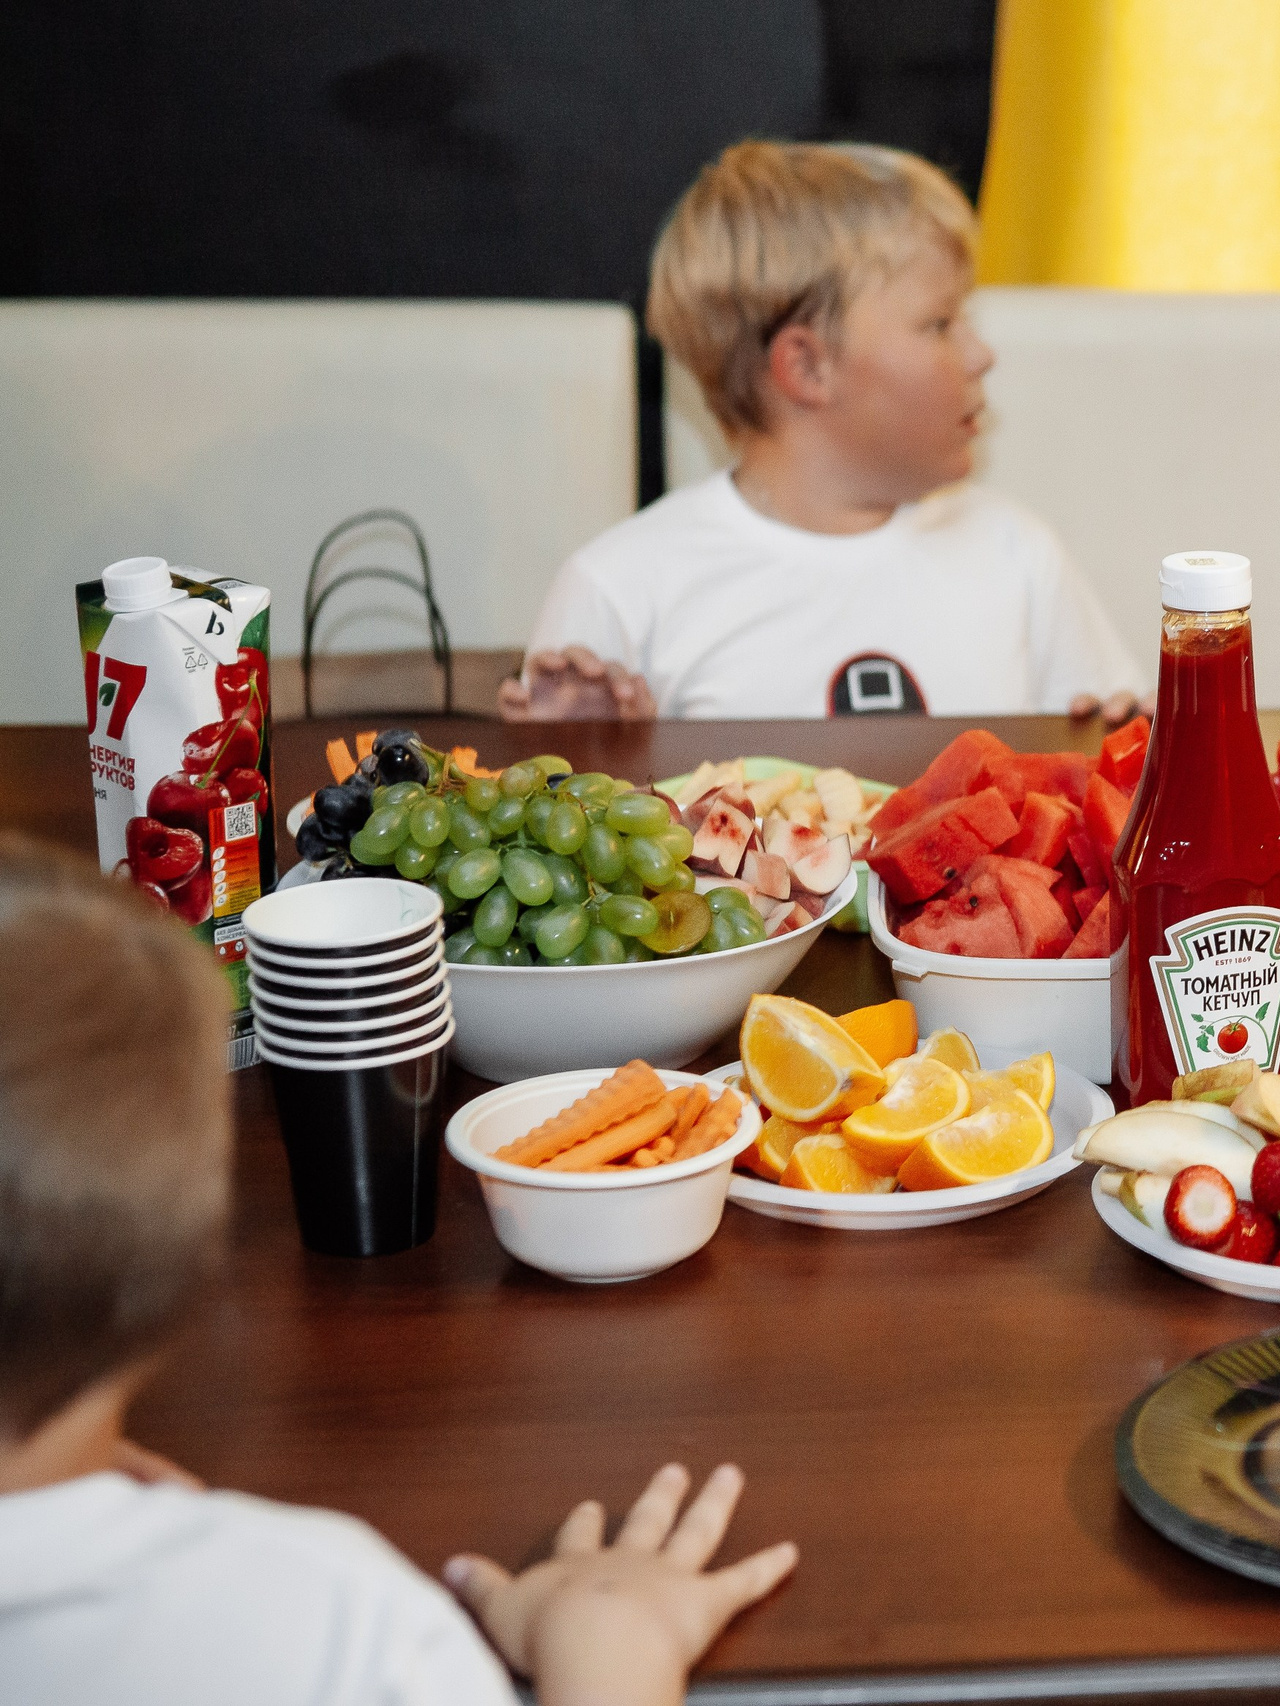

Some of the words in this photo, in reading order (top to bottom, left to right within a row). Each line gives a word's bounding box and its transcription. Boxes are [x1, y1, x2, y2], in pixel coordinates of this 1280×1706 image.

[1193, 928, 1271, 962] HEINZ
[1235, 956, 1252, 964] 1869
[1181, 962, 1278, 995] ТОМАТНЫЙ
[1203, 989, 1261, 1012] КЕТЧУП
